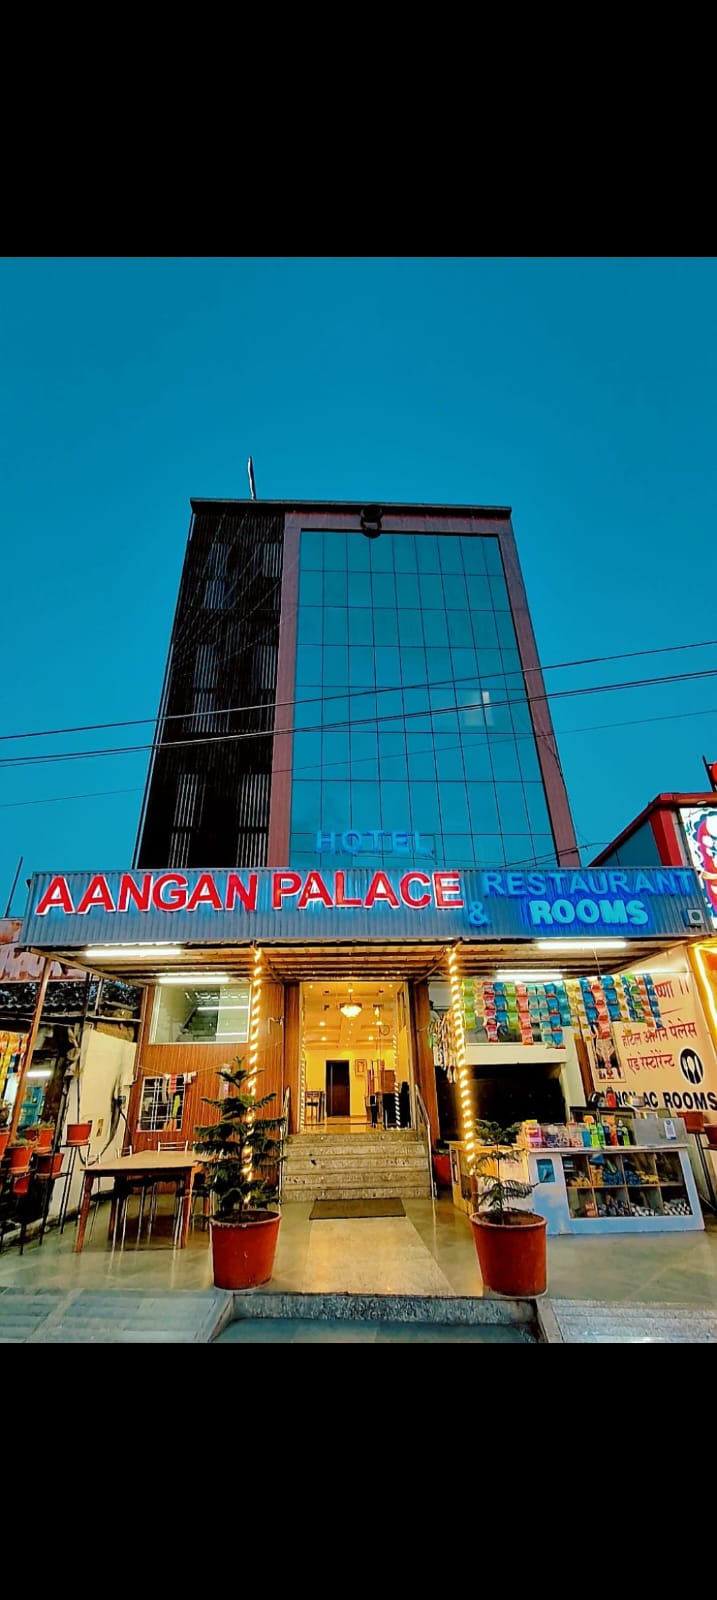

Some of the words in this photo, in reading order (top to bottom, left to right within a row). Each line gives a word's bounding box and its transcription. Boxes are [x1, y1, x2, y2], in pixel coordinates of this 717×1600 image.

[315, 829, 433, 856] HOTEL
[35, 871, 259, 915] AANGAN
[272, 869, 465, 911] PALACE
[481, 869, 693, 898] RESTAURANT
[468, 900, 491, 928] &
[528, 898, 650, 927] ROOMS
